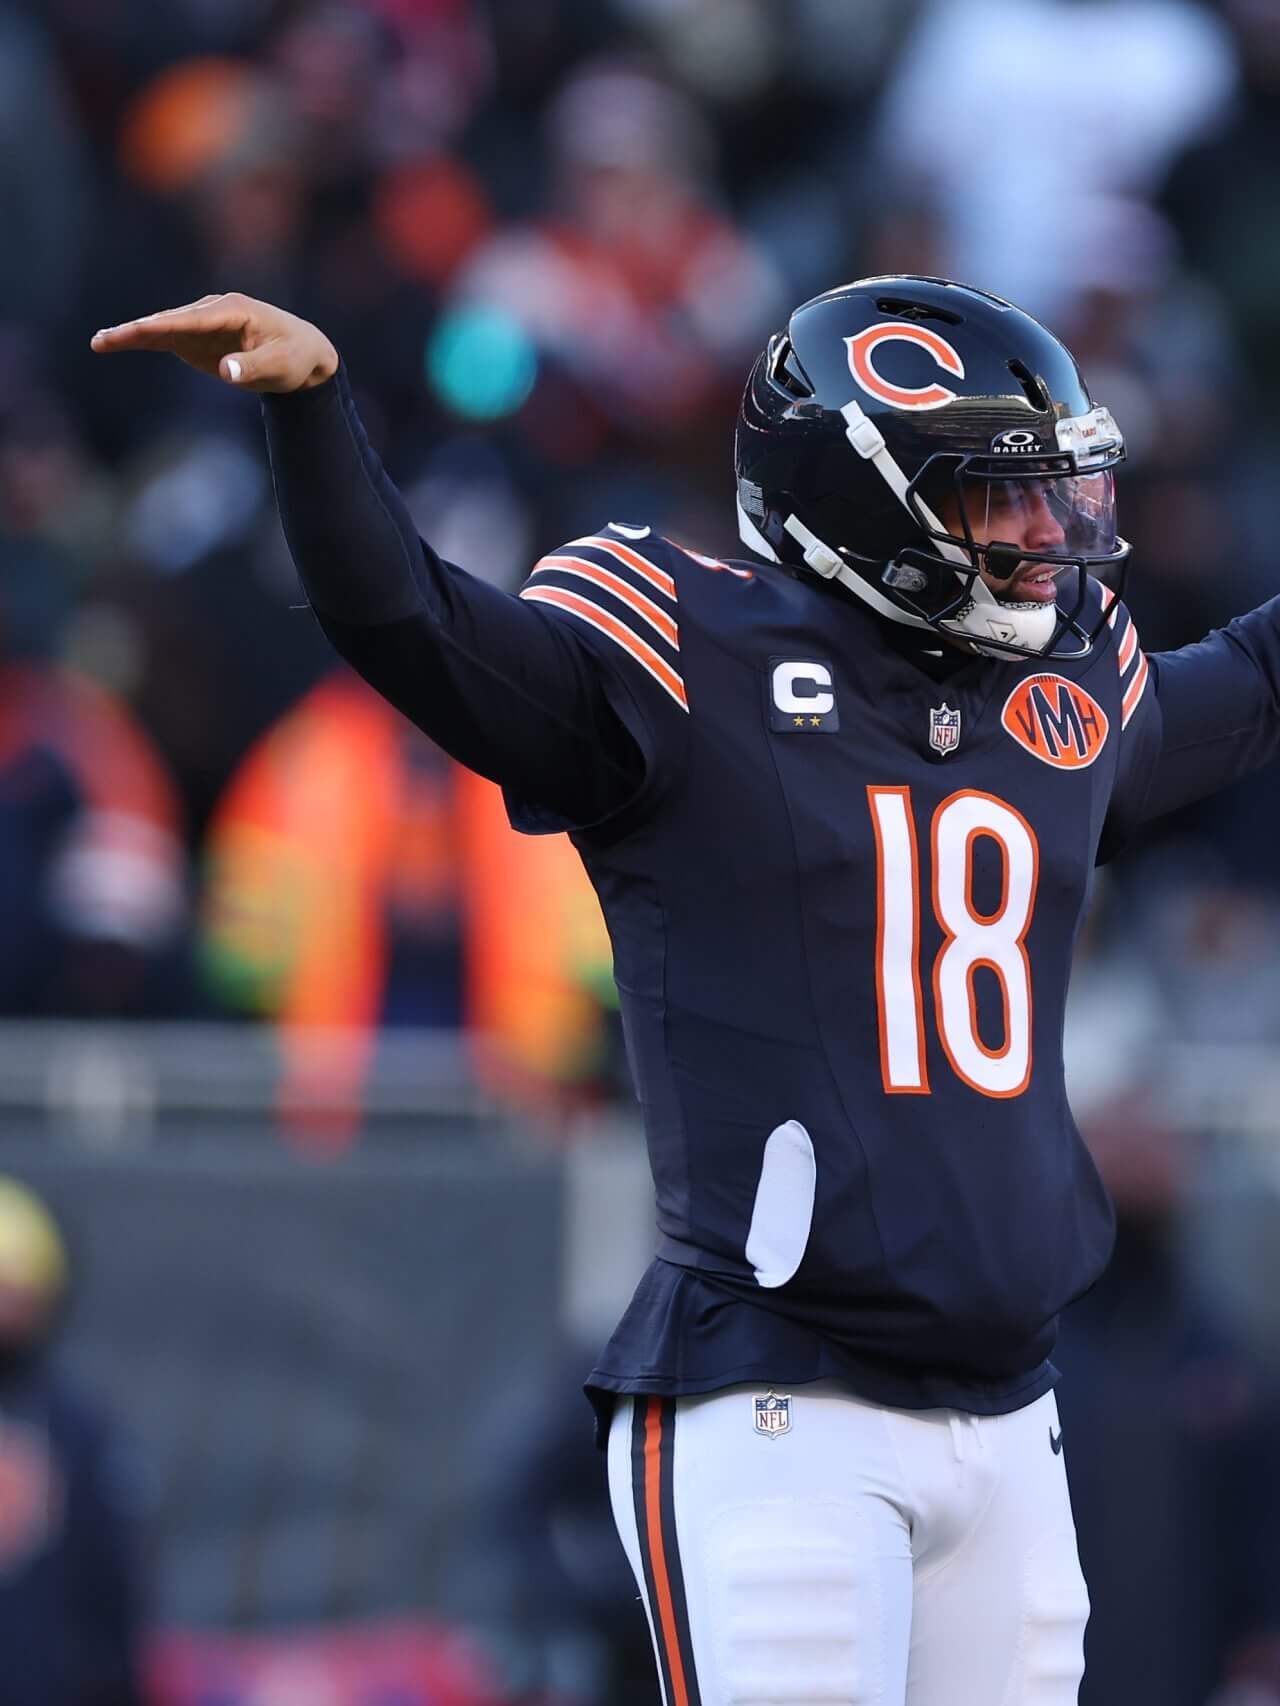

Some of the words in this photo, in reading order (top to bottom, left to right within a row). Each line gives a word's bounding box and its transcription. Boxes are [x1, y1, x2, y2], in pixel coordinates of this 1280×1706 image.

[842, 322, 965, 411] C
[993, 444, 1042, 454] OAKLEY
[772, 661, 834, 714] C
[935, 726, 957, 746] NFL
[866, 785, 1040, 1099] 18
[759, 1411, 786, 1430] NFL
